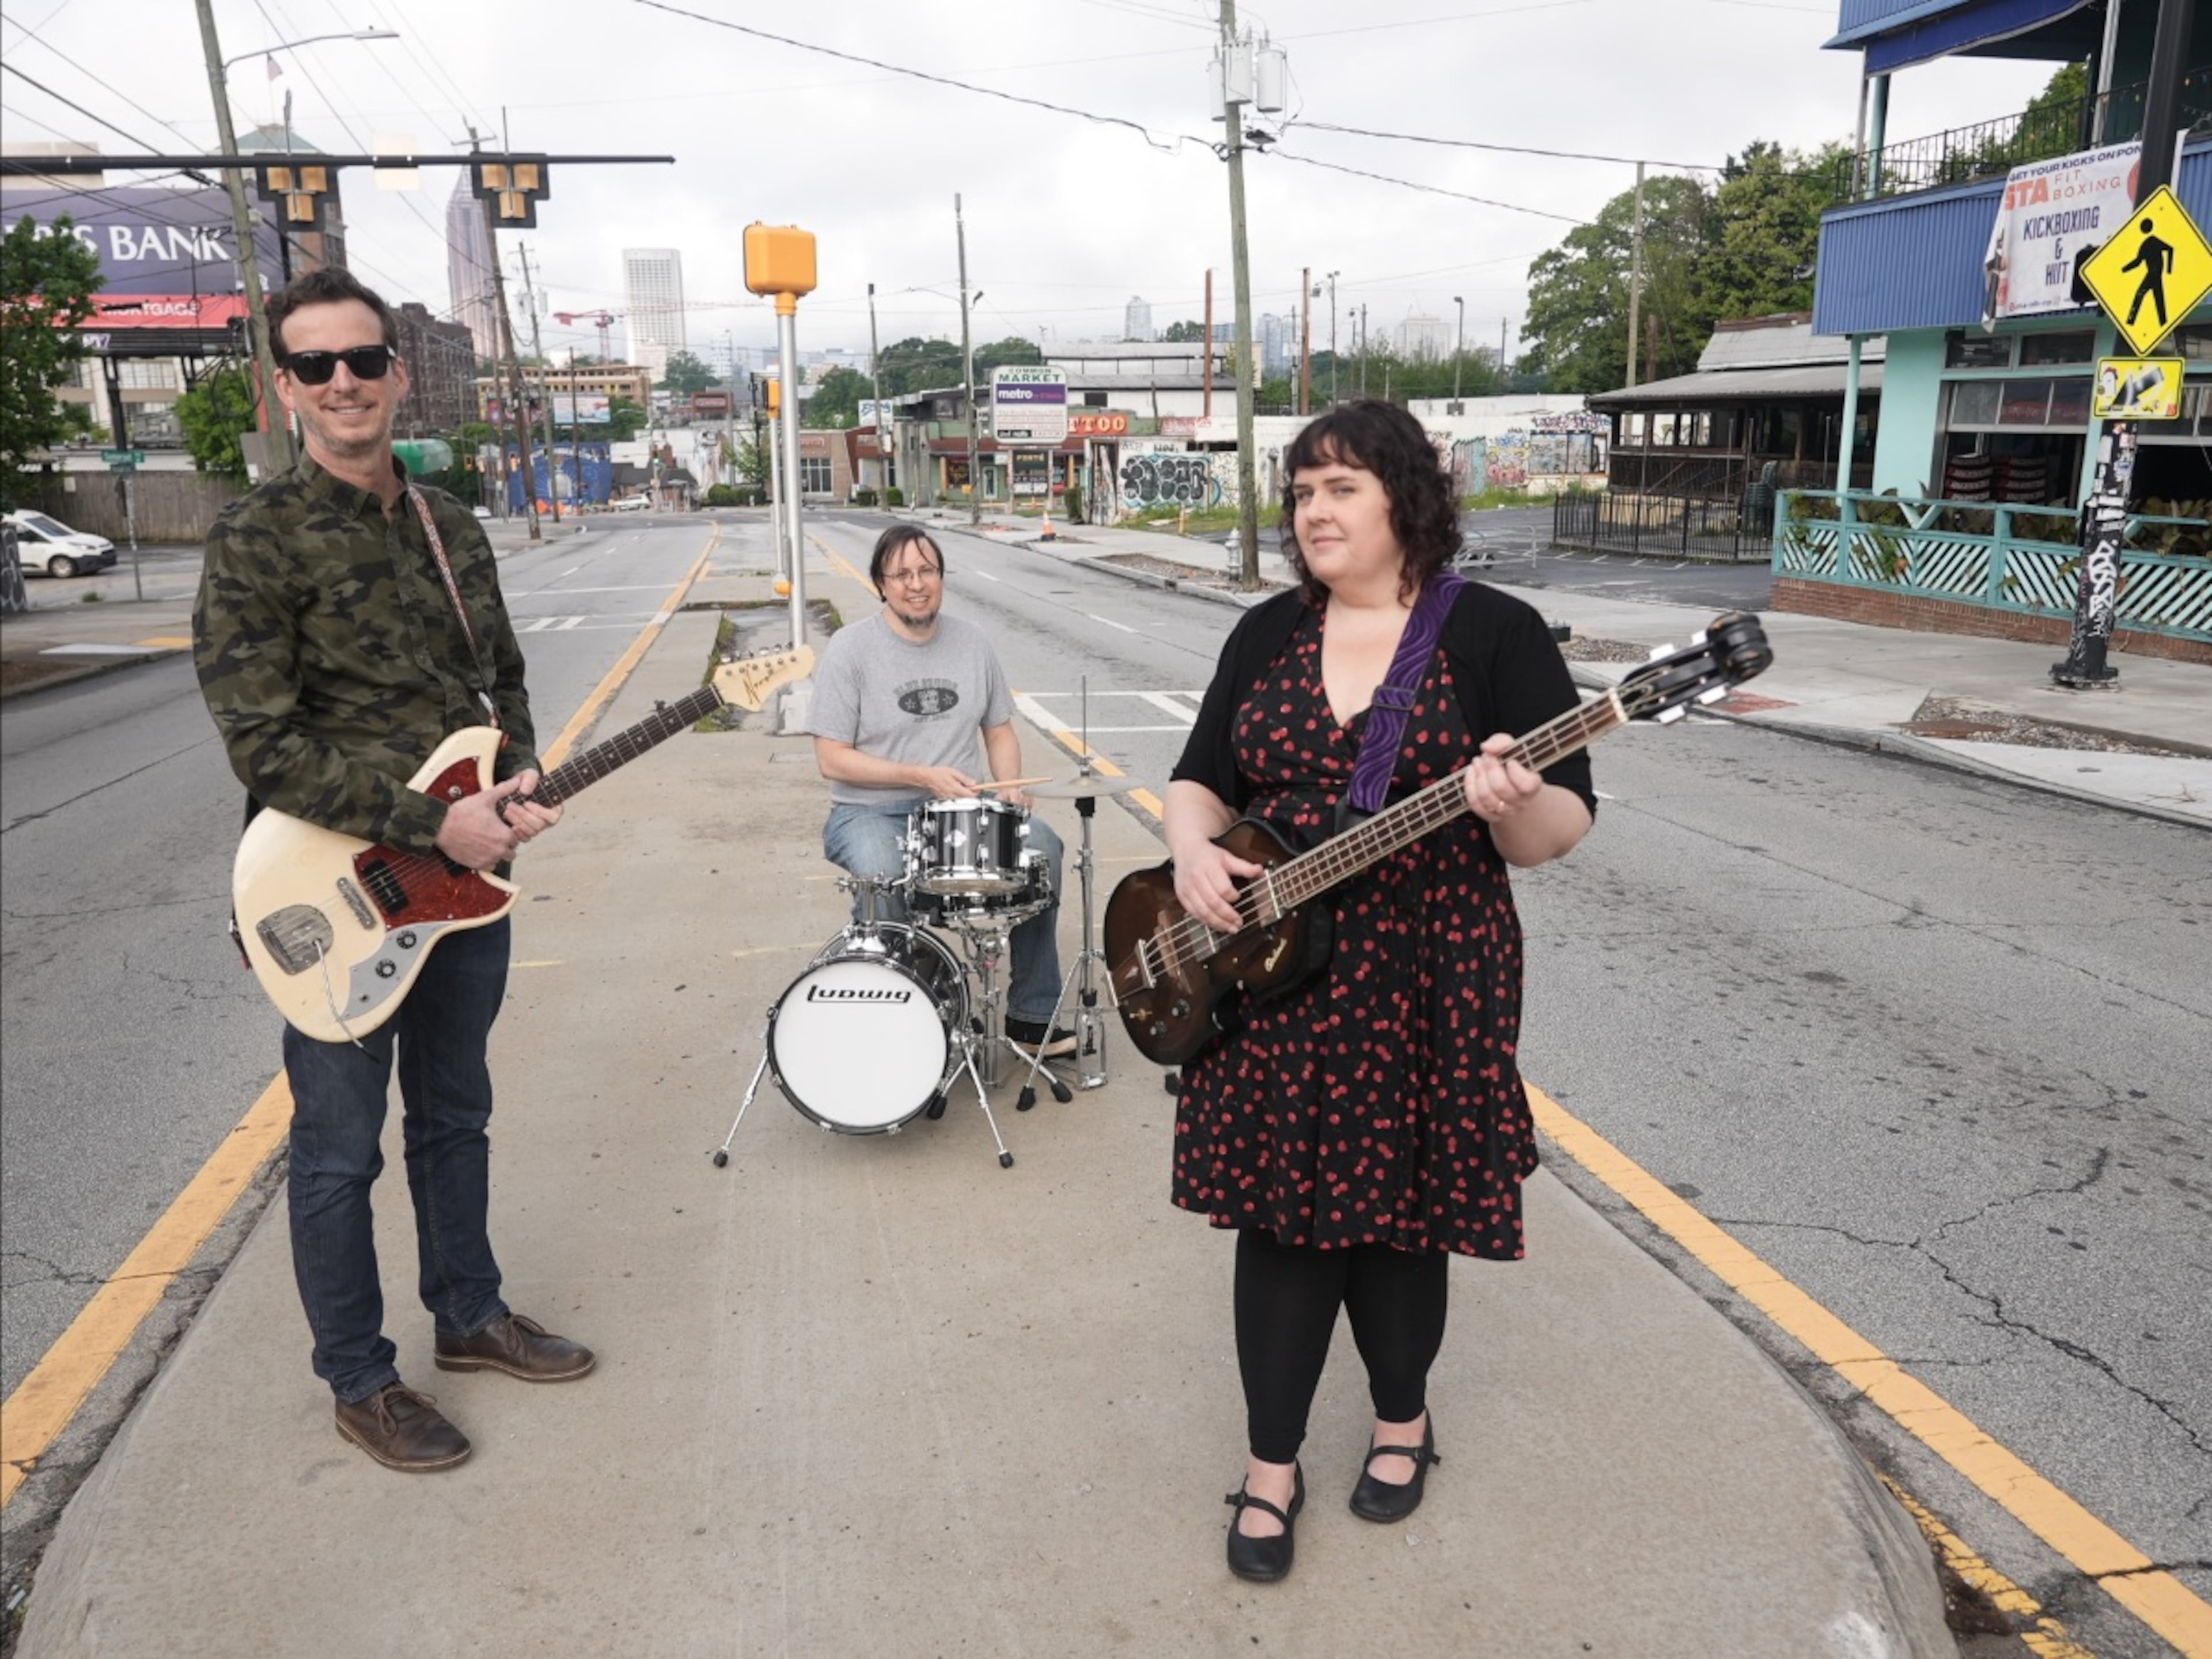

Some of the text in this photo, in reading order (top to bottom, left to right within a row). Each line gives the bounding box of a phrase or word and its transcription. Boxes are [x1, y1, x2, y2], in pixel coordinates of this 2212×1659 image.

[2009, 171, 2028, 181] GET
[2030, 164, 2059, 177] YOUR
[2062, 154, 2096, 170] KICKS
[2097, 152, 2115, 162] ON
[2054, 169, 2082, 185] FIT
[2052, 176, 2121, 200] BOXING
[2023, 206, 2100, 241] KICKBOXING
[108, 225, 230, 260] BANK
[2054, 237, 2063, 259] &
[2046, 261, 2070, 286] HIIT
[998, 389, 1033, 399] metro
